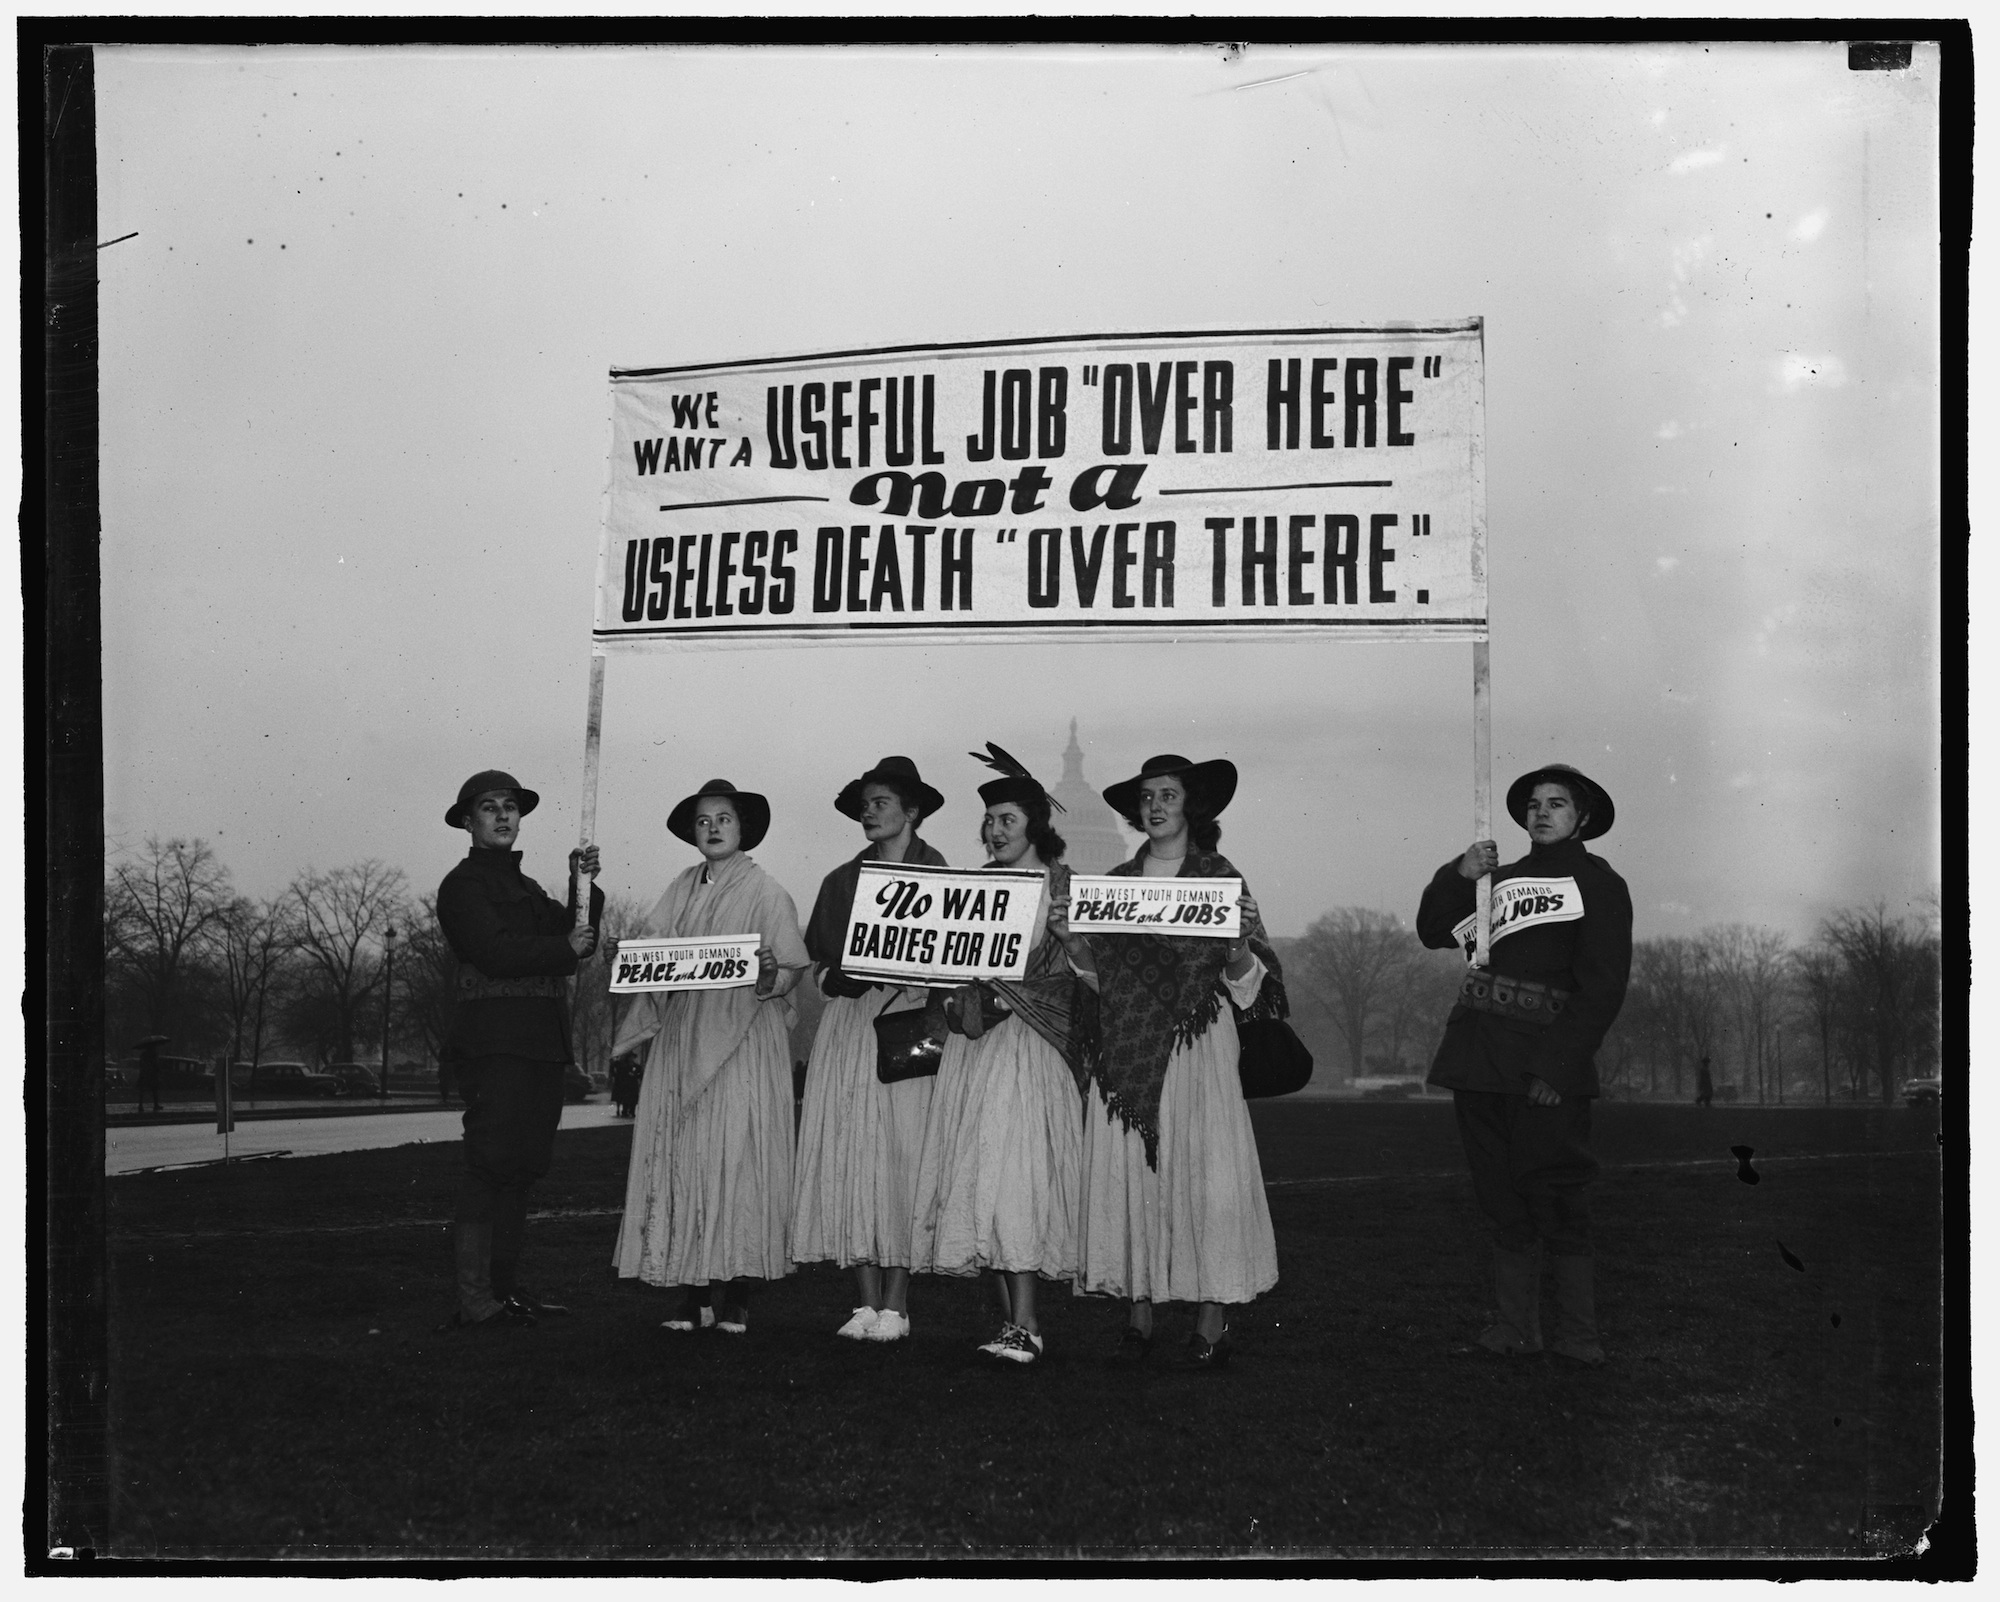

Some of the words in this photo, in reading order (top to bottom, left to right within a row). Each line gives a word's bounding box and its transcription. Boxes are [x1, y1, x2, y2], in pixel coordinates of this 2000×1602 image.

[671, 391, 719, 430] WE
[767, 374, 945, 470] USEFUL
[966, 366, 1068, 462] JOB
[1083, 360, 1234, 456] "OVER
[1267, 355, 1441, 450] HERE"
[634, 437, 727, 476] WANT
[730, 437, 752, 467] A
[622, 529, 798, 622] USELESS
[812, 524, 975, 613] DEATH
[997, 520, 1177, 608] "OVER
[875, 880, 933, 920] No
[943, 887, 1010, 921] WAR
[1079, 887, 1135, 901] MID-WEST
[1141, 888, 1172, 901] YOUTH
[1176, 889, 1224, 903] DEMANDS
[1506, 886, 1553, 901] DEMANDS
[1509, 894, 1565, 921] JOBS
[1074, 900, 1140, 922] PEACE
[1137, 905, 1168, 924] and
[1168, 903, 1231, 926] JOBS
[621, 951, 664, 963] MID-WEST
[669, 949, 694, 961] YOUTH
[699, 947, 742, 960] DEMANDS
[849, 922, 938, 964] BABIES
[941, 931, 985, 966] FOR
[988, 933, 1022, 968] US
[616, 962, 677, 984] PEACE
[673, 964, 698, 982] and
[698, 959, 749, 980] JOBS
